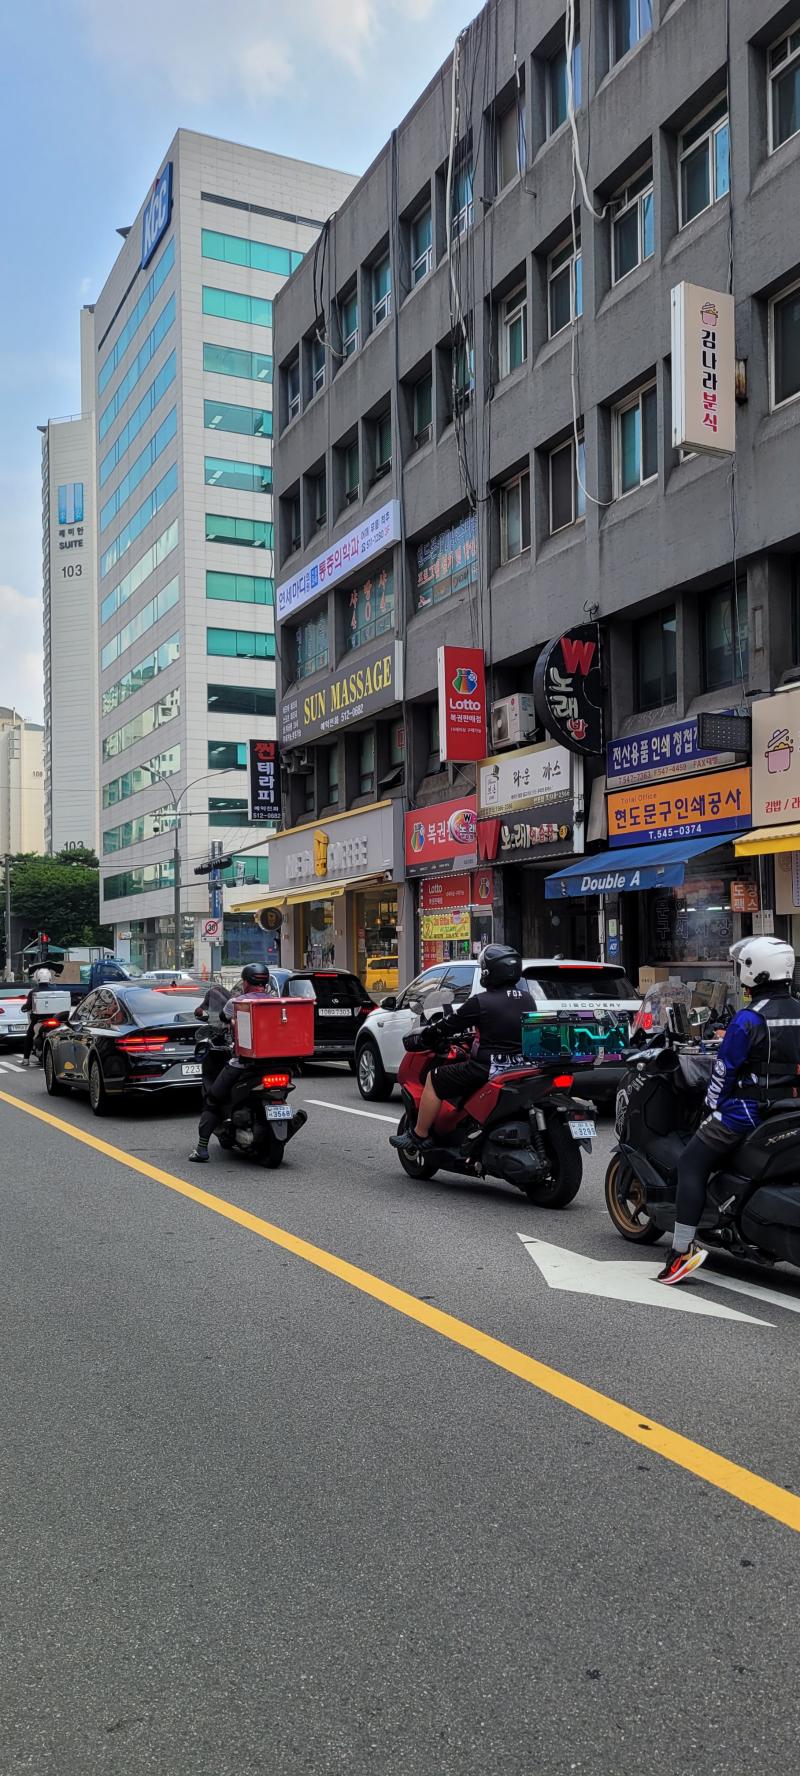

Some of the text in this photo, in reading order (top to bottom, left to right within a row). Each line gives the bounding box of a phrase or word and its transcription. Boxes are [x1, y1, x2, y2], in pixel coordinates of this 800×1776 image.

[143, 179, 167, 258] KCC
[702, 329, 717, 433] 김나라분식
[59, 540, 83, 550] SUITE
[62, 564, 83, 578] 103
[561, 636, 596, 676] W
[304, 690, 326, 725] SUN
[331, 656, 392, 712] MASSAGE
[450, 698, 481, 710] Lotto
[450, 713, 481, 723] 복권판매점
[613, 739, 649, 770] 전산용품
[651, 733, 671, 760] 인쇄
[620, 793, 657, 804] Total Office
[615, 788, 741, 829] 현도문구인쇄공사
[765, 800, 781, 813] 김밥
[649, 824, 702, 840] T.545-0374
[476, 820, 501, 861] W
[581, 872, 626, 891] Double
[630, 870, 640, 886] A
[429, 883, 442, 894] Lotto
[734, 885, 758, 897] 도장
[733, 898, 758, 911] 팩스
[208, 924, 215, 932] 30
